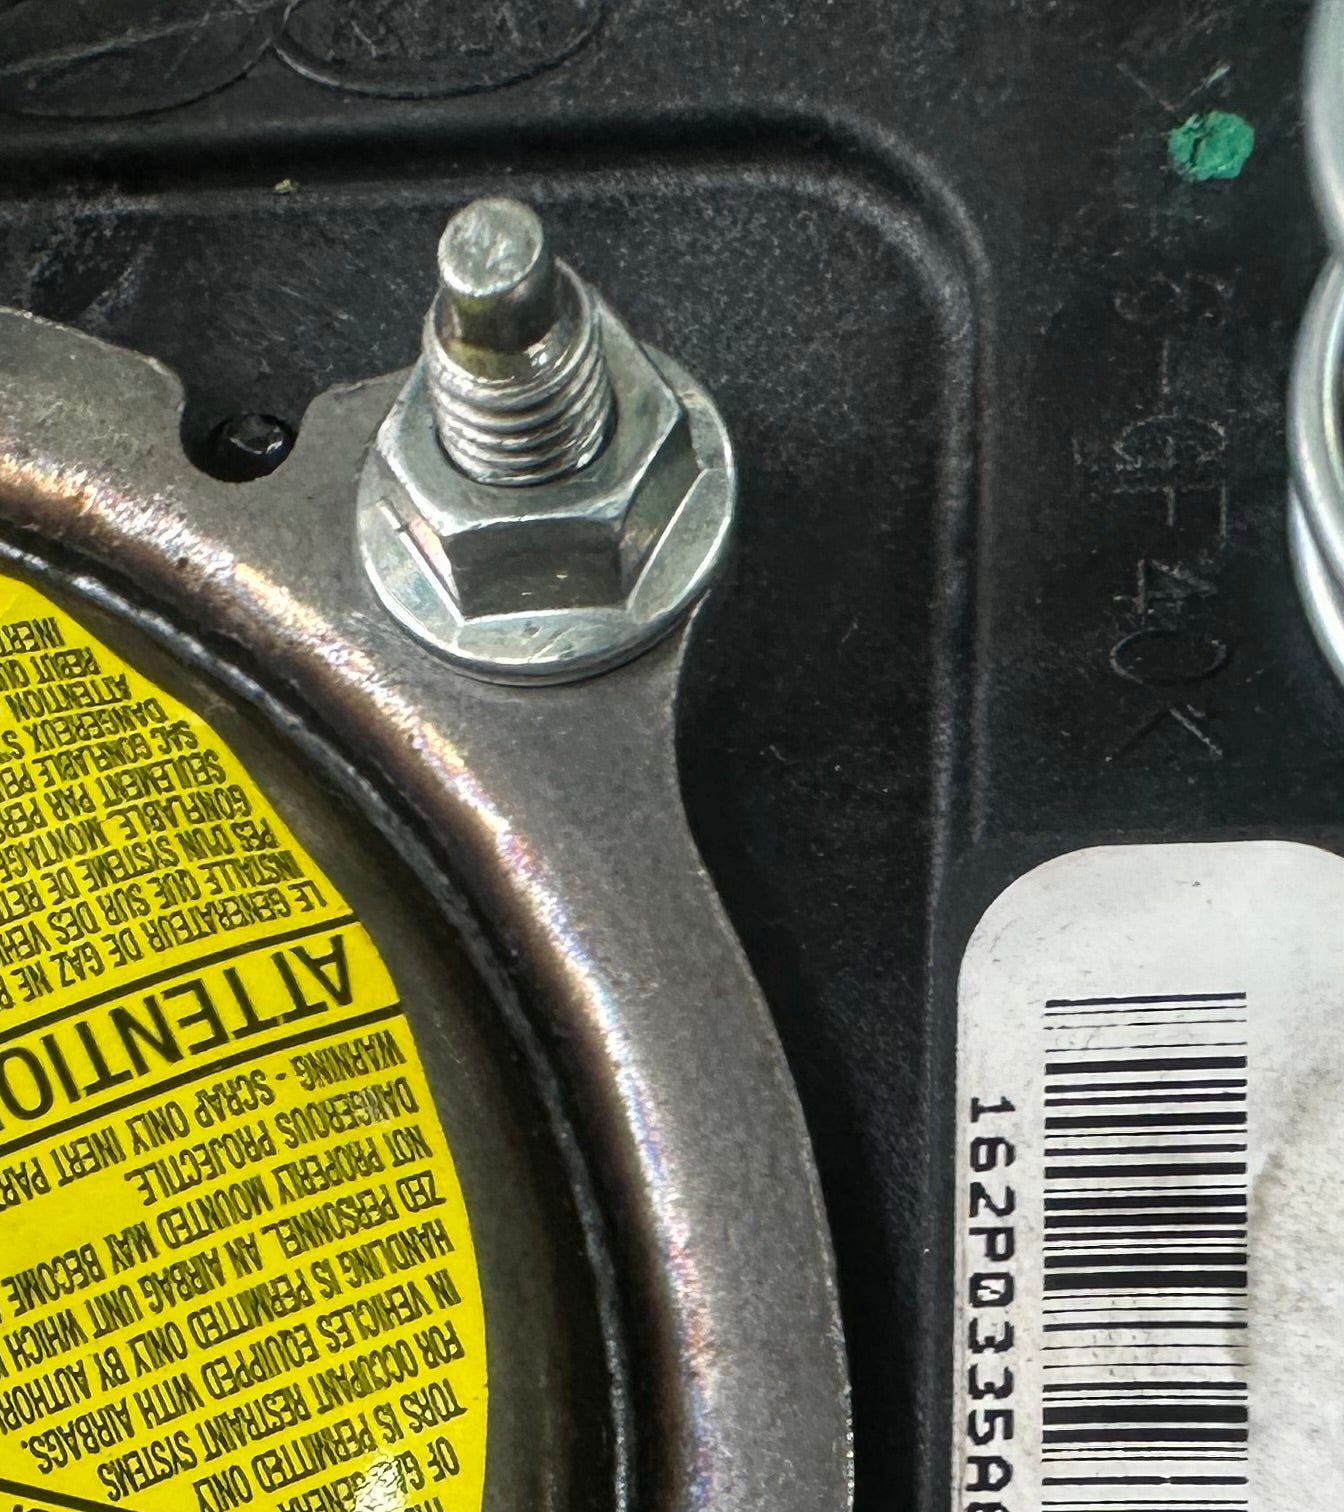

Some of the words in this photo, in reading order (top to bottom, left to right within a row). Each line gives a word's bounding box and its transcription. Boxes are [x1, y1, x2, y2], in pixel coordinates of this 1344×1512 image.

[4, 671, 132, 723] ATTENTION
[149, 719, 198, 755] SAC
[43, 782, 97, 822] PAR
[96, 749, 227, 809] SEULEMENT
[74, 835, 179, 893] SYSTEME
[229, 817, 279, 853] PES
[147, 869, 202, 910] QUE
[197, 845, 305, 896] INSTALLE
[46, 901, 101, 945] DES
[95, 883, 151, 926] SUR
[140, 887, 292, 953] GENERATEUR
[49, 941, 105, 988] GAZ
[289, 1029, 407, 1092] WARNING
[194, 1069, 275, 1128] SCRAP
[274, 1076, 420, 1149] DANGEROUS
[49, 1125, 127, 1187] INERT
[124, 1101, 191, 1156] ONLY
[382, 1124, 434, 1168] NOT
[270, 1137, 386, 1205] PROPERLY
[395, 1169, 447, 1213] ZED
[156, 1175, 274, 1250] MOUNTED
[102, 1220, 160, 1275] MAY
[335, 1218, 455, 1289] HANDLING
[0, 1242, 107, 1318] BECOME
[136, 1247, 226, 1315] AIRBAG
[186, 1268, 316, 1350] PERMITTED
[2, 1308, 89, 1372] WHICH
[83, 1284, 144, 1340] UNIT
[316, 1281, 433, 1353] VEHICLES
[125, 1321, 188, 1378] ONLY
[200, 1323, 320, 1400] EQUIPPED
[412, 1320, 465, 1370] FOR
[132, 1372, 205, 1430] WITH
[307, 1339, 419, 1415] OCCUPANT
[399, 1378, 468, 1434] TORS
[20, 1397, 135, 1475] AIRBAGS.
[194, 1382, 312, 1463] RESTRAINT
[96, 1430, 198, 1502] SYSTEMS
[250, 1413, 378, 1494] PERMITTED
